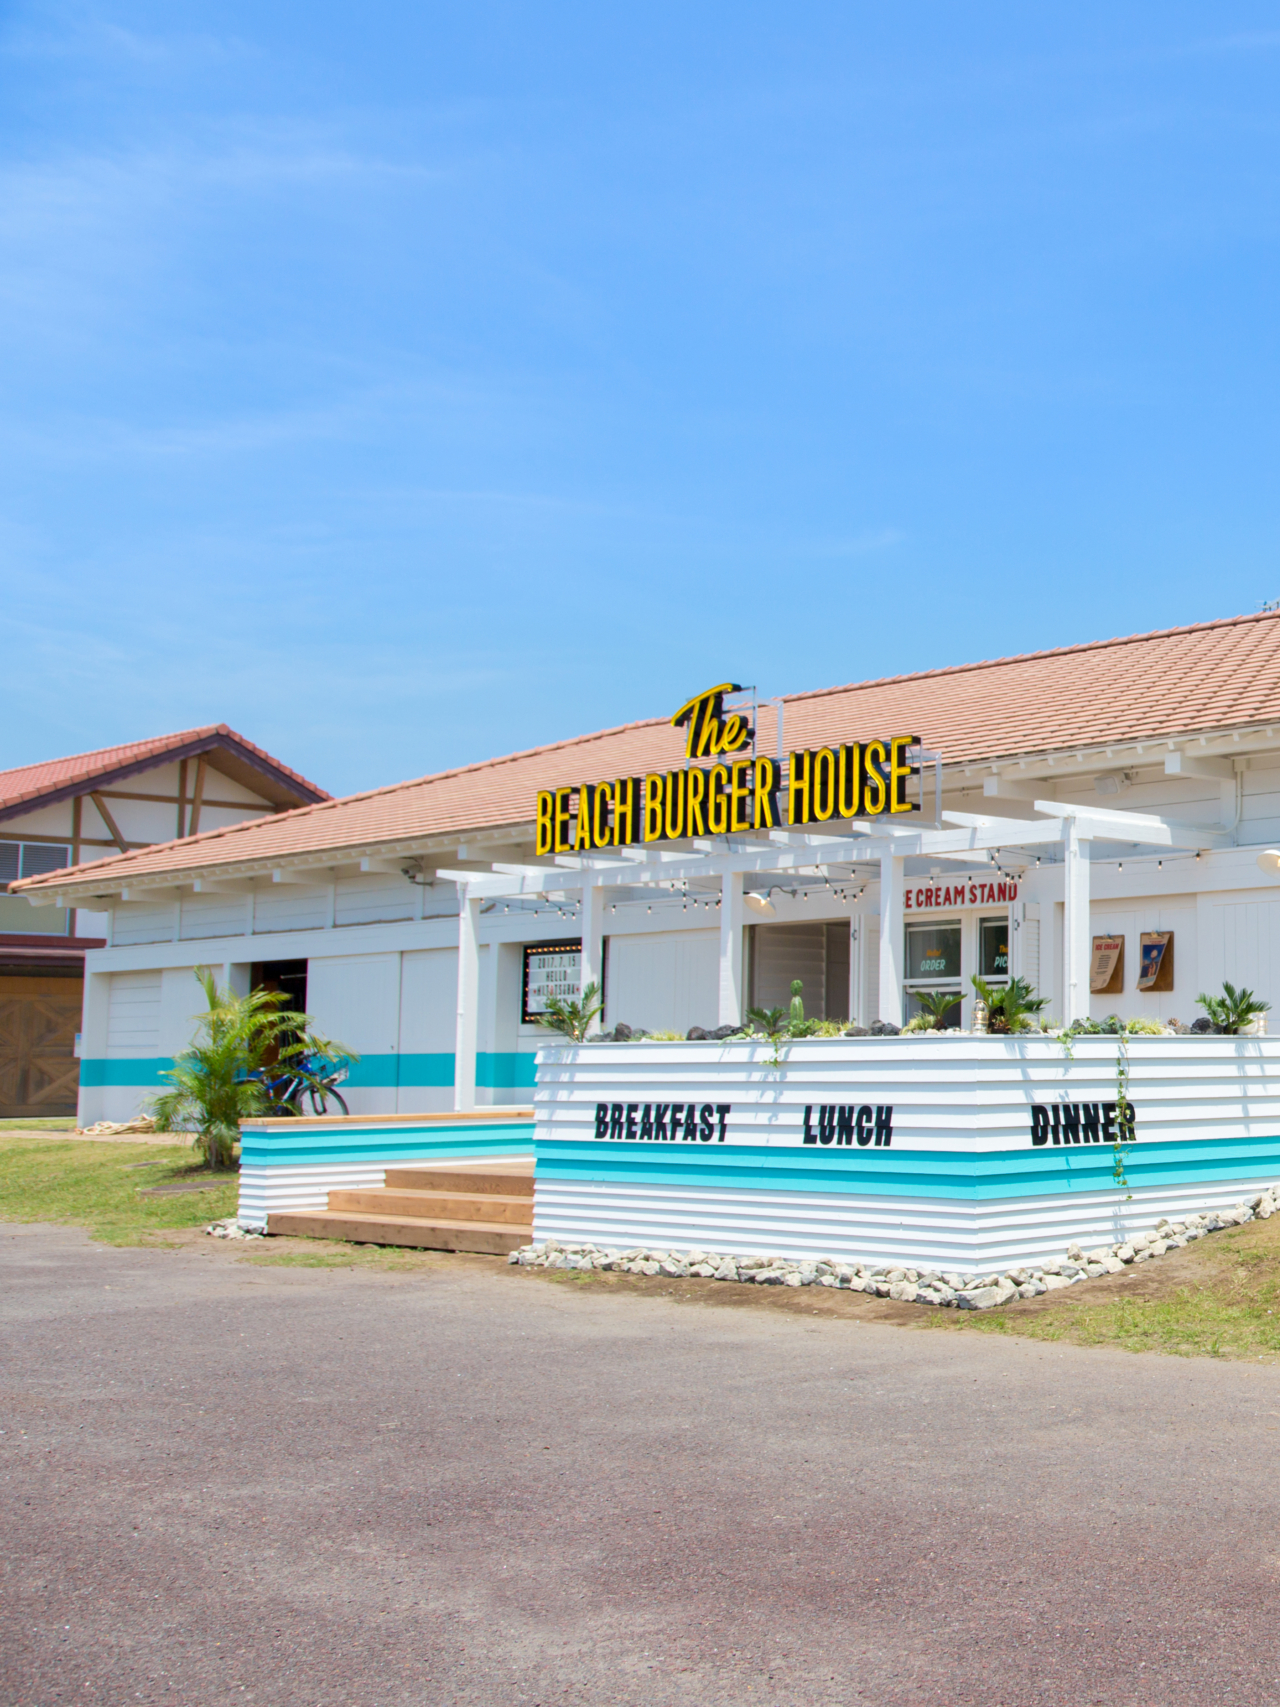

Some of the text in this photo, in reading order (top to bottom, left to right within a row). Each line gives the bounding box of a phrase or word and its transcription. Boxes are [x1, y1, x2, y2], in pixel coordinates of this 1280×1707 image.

[671, 682, 754, 758] The
[536, 735, 919, 857] BEACH BURGER HOUSE
[916, 885, 966, 908] CREAM
[969, 882, 1018, 904] STAND
[537, 955, 576, 969] 2017.7.15
[920, 959, 946, 971] ORDER
[994, 956, 1008, 968] PIC
[546, 970, 567, 982] HELLO
[594, 1102, 1137, 1147] BREAKFAST LUNCH DINNER
